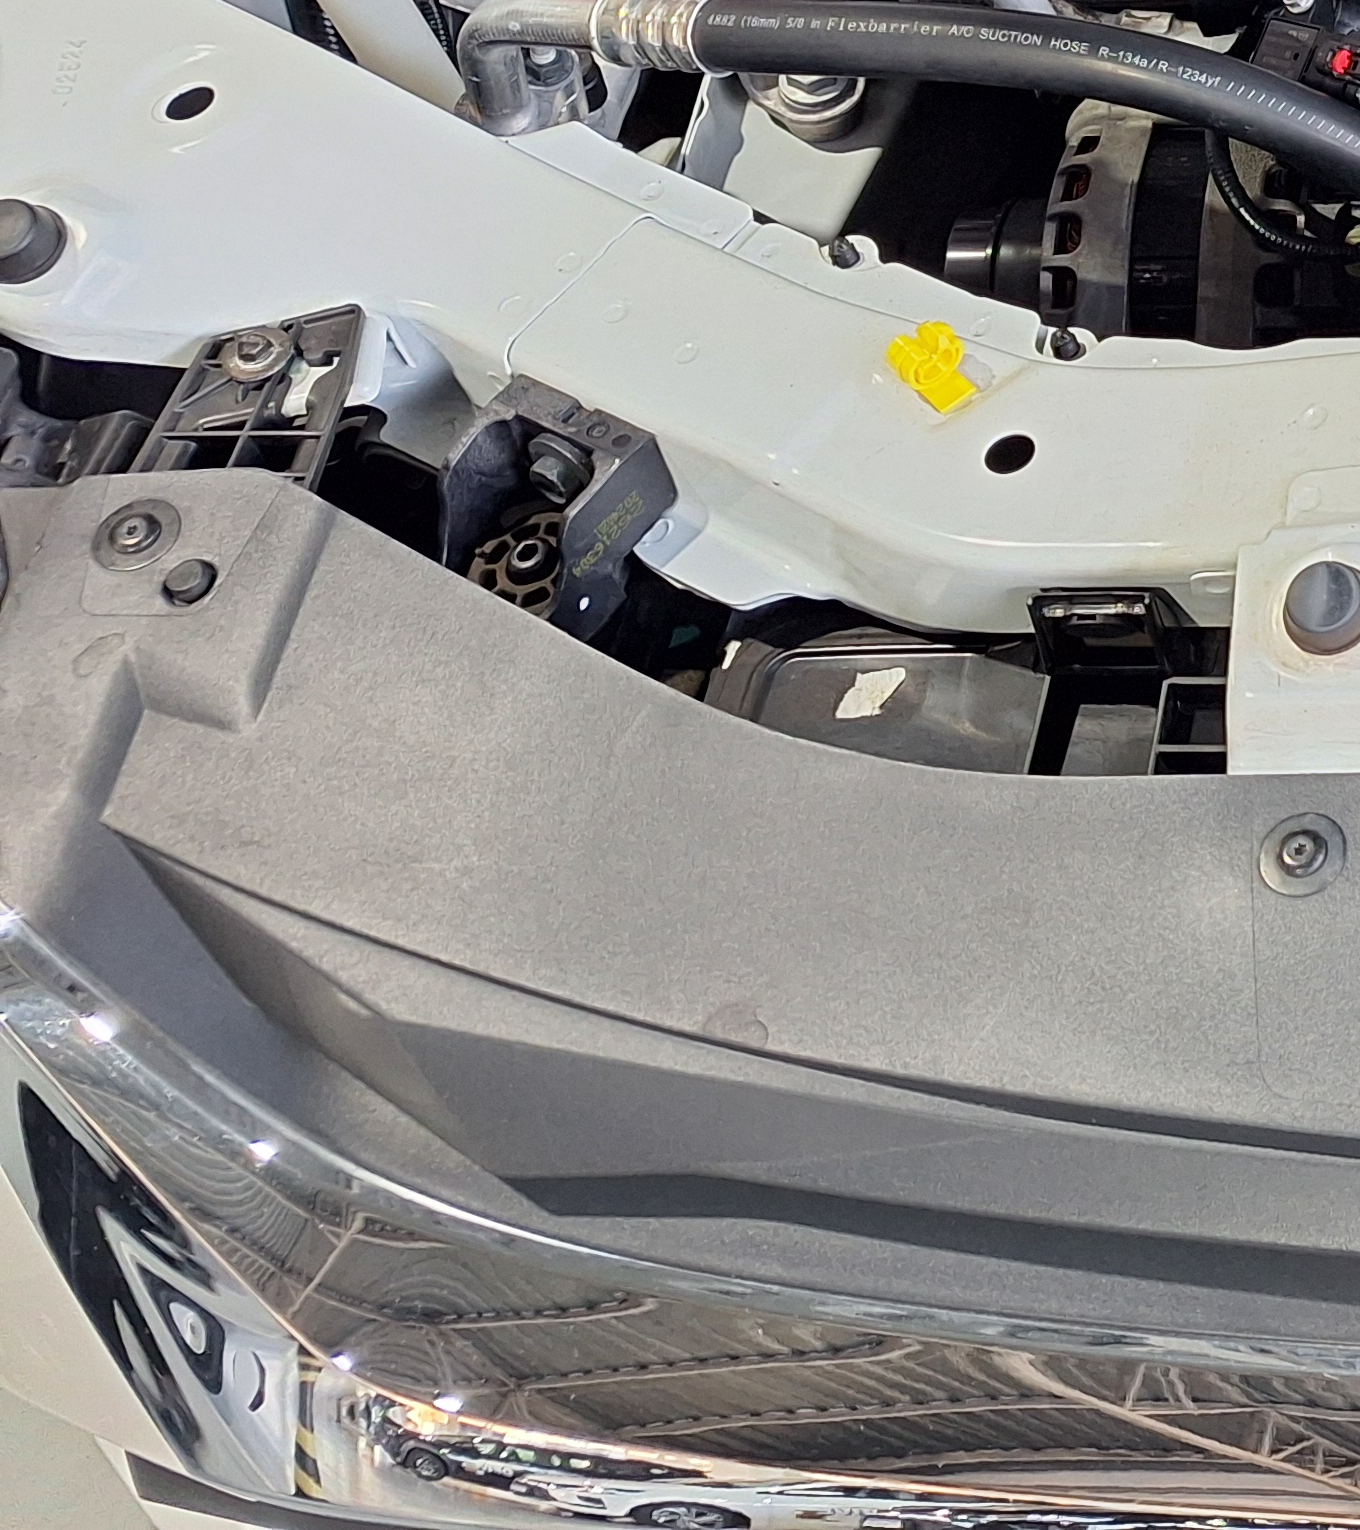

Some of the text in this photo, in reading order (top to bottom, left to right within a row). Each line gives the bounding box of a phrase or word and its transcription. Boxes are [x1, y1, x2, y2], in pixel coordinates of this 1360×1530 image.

[949, 25, 975, 38] A/C
[979, 27, 1044, 47] SUCTION
[1050, 38, 1091, 55] HOSE
